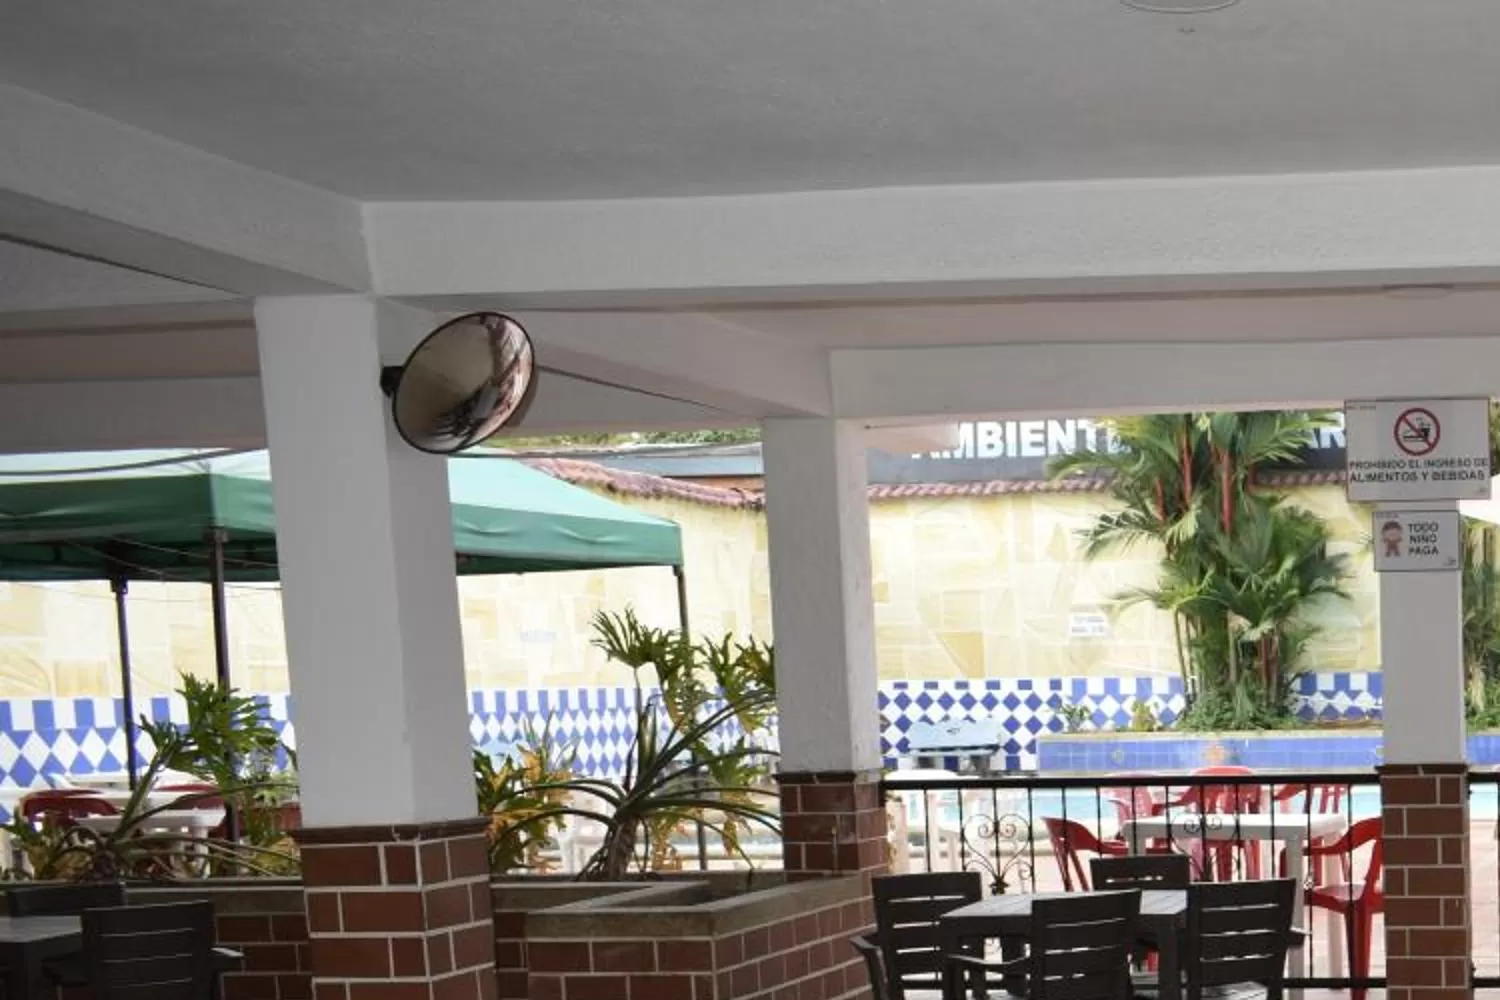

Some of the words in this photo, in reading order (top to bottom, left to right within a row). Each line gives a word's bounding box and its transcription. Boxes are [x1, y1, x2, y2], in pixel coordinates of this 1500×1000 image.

[911, 417, 1131, 459] MBIENTE
[1349, 460, 1407, 470] PROHIBIDO
[1408, 459, 1421, 469] EL
[1424, 458, 1471, 469] INGRESO
[1473, 457, 1488, 467] DE
[1349, 471, 1418, 482] ALIMENTOS
[1420, 471, 1429, 480] Y
[1431, 470, 1485, 480] BEBIDAS
[1408, 522, 1439, 532] TODO
[1408, 546, 1439, 556] PAGA
